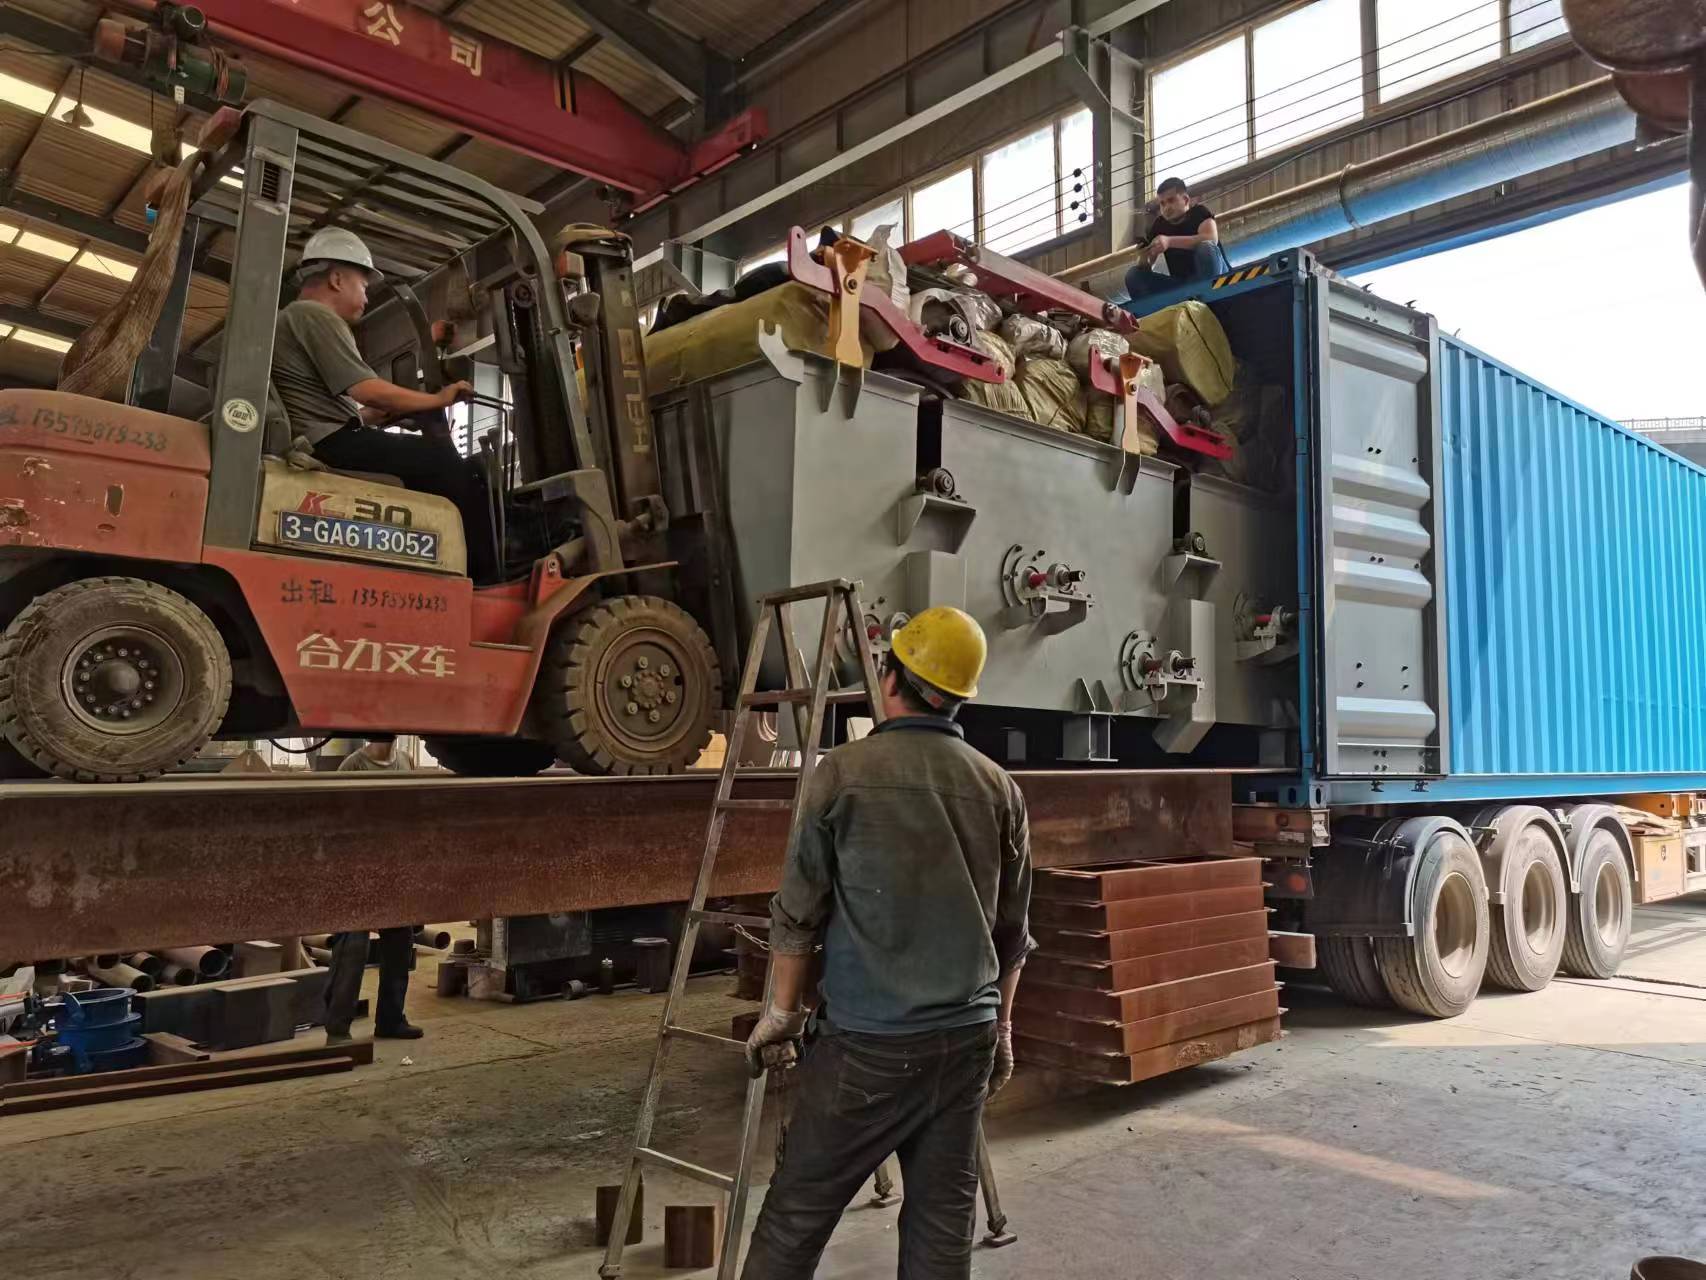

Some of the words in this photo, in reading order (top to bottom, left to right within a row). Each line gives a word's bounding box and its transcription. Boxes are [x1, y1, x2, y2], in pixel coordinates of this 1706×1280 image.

[363, 1, 483, 77] 公司
[352, 497, 412, 528] 30
[284, 514, 435, 558] 3-GA613052
[281, 578, 336, 605] 出租
[296, 633, 457, 678] 合力叉车
